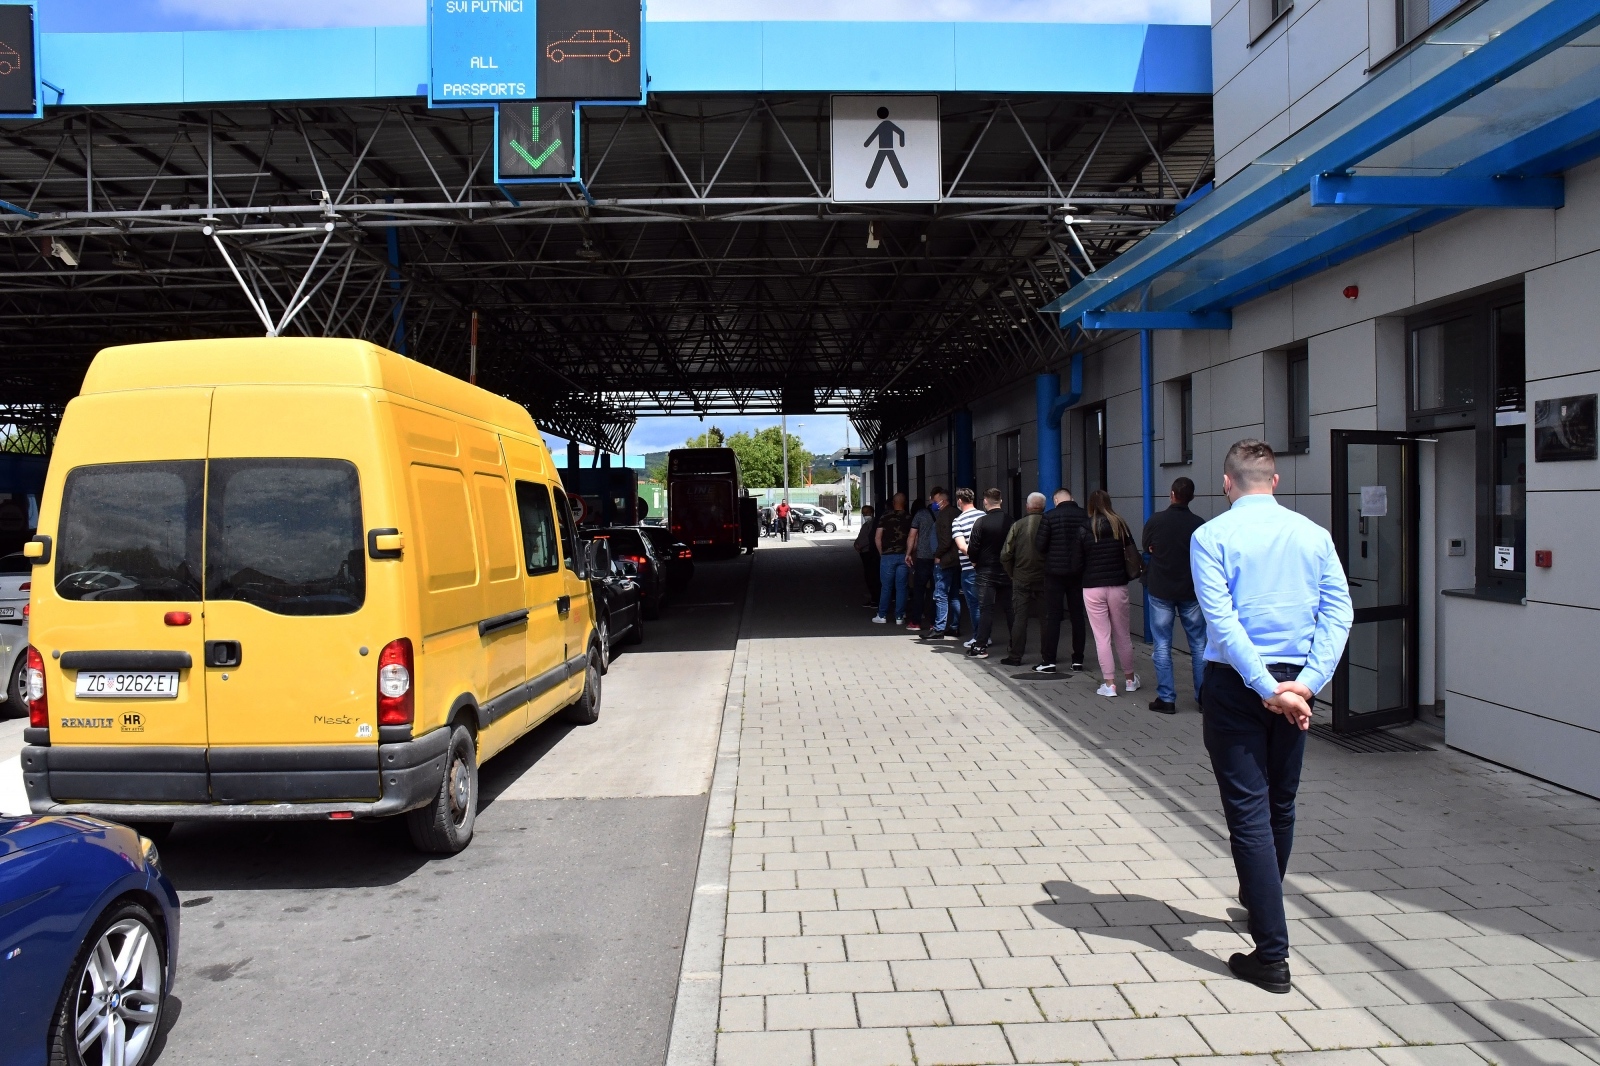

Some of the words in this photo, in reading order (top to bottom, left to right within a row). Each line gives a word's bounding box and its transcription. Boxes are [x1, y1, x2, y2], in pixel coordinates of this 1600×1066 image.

[446, 1, 467, 13] SVI
[471, 1, 523, 13] PUTNICI
[470, 56, 498, 68] ALL
[443, 83, 526, 96] PASSPORTS
[87, 675, 105, 692] ZG
[61, 718, 114, 728] RENAULT
[123, 714, 141, 725] HR
